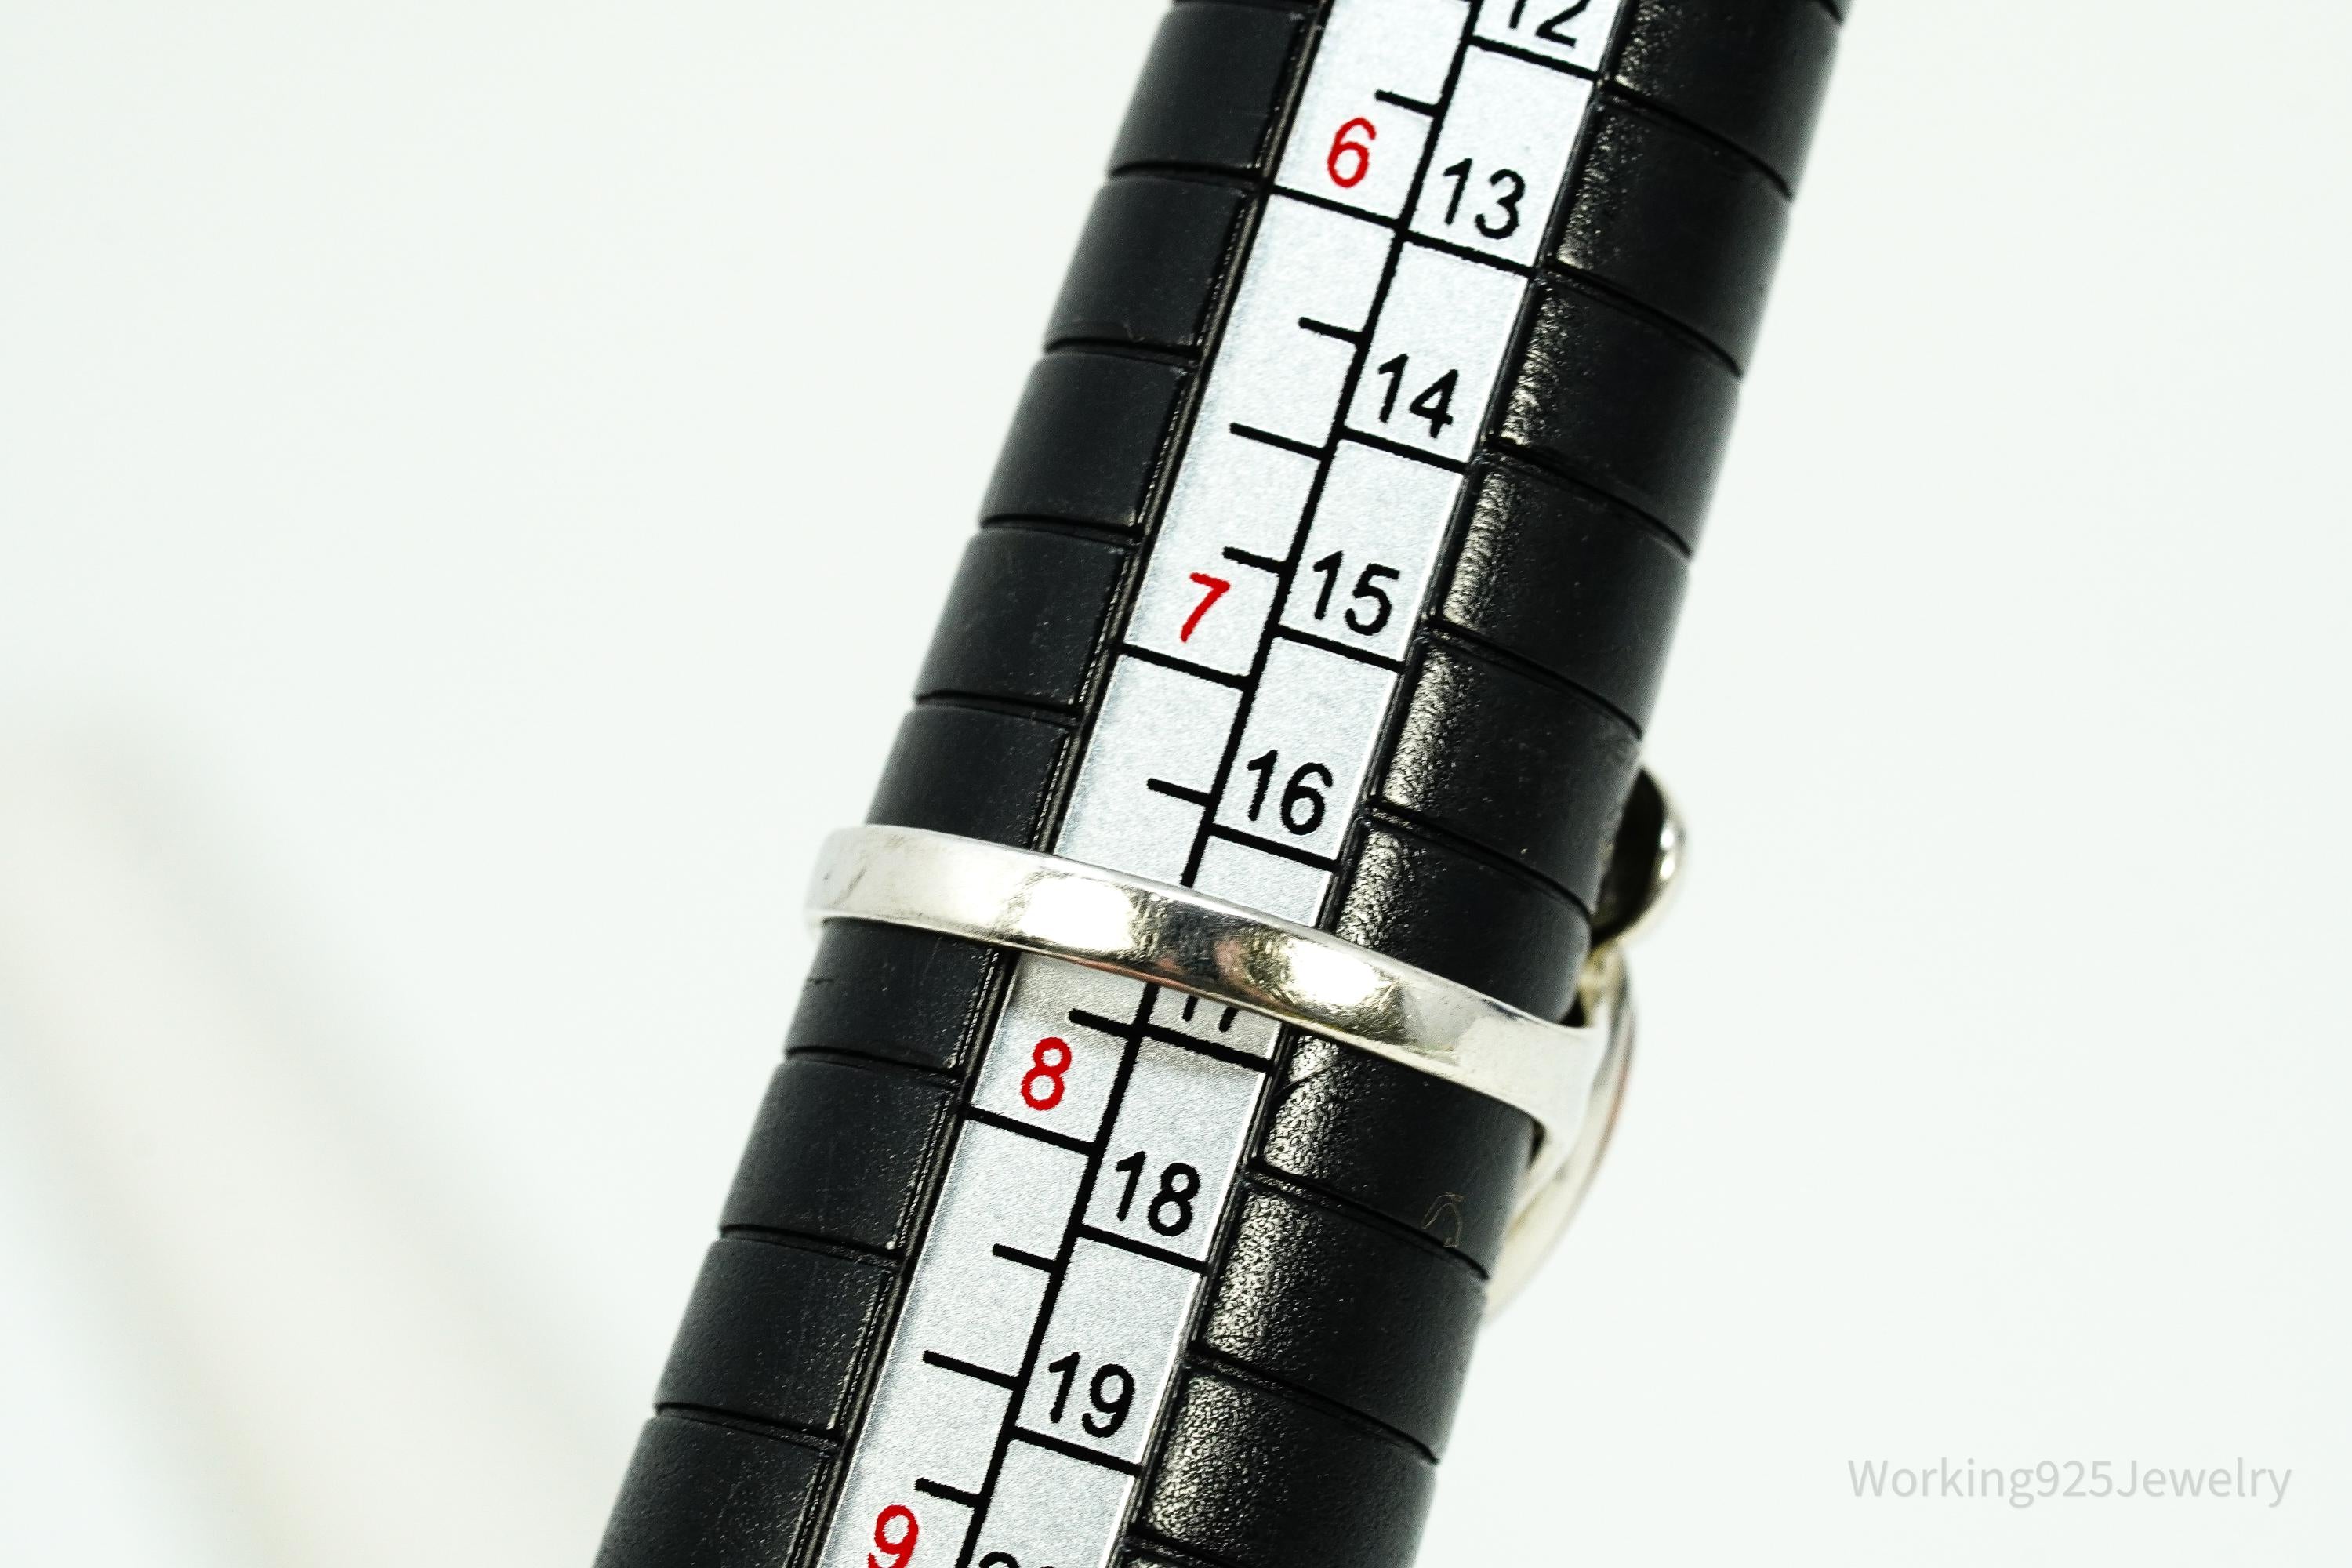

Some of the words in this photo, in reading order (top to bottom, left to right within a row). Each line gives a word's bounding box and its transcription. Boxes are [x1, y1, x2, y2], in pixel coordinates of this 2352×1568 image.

[1327, 117, 1377, 188] 6
[1443, 158, 1526, 240] 13
[1377, 353, 1459, 439] 14
[1180, 572, 1231, 643] 7
[1312, 550, 1401, 637] 15
[1247, 749, 1334, 836] 16
[1020, 1036, 1073, 1112] 8
[1115, 1150, 1201, 1237] 18
[1047, 1351, 1136, 1439] 19
[868, 1504, 920, 1568] 9
